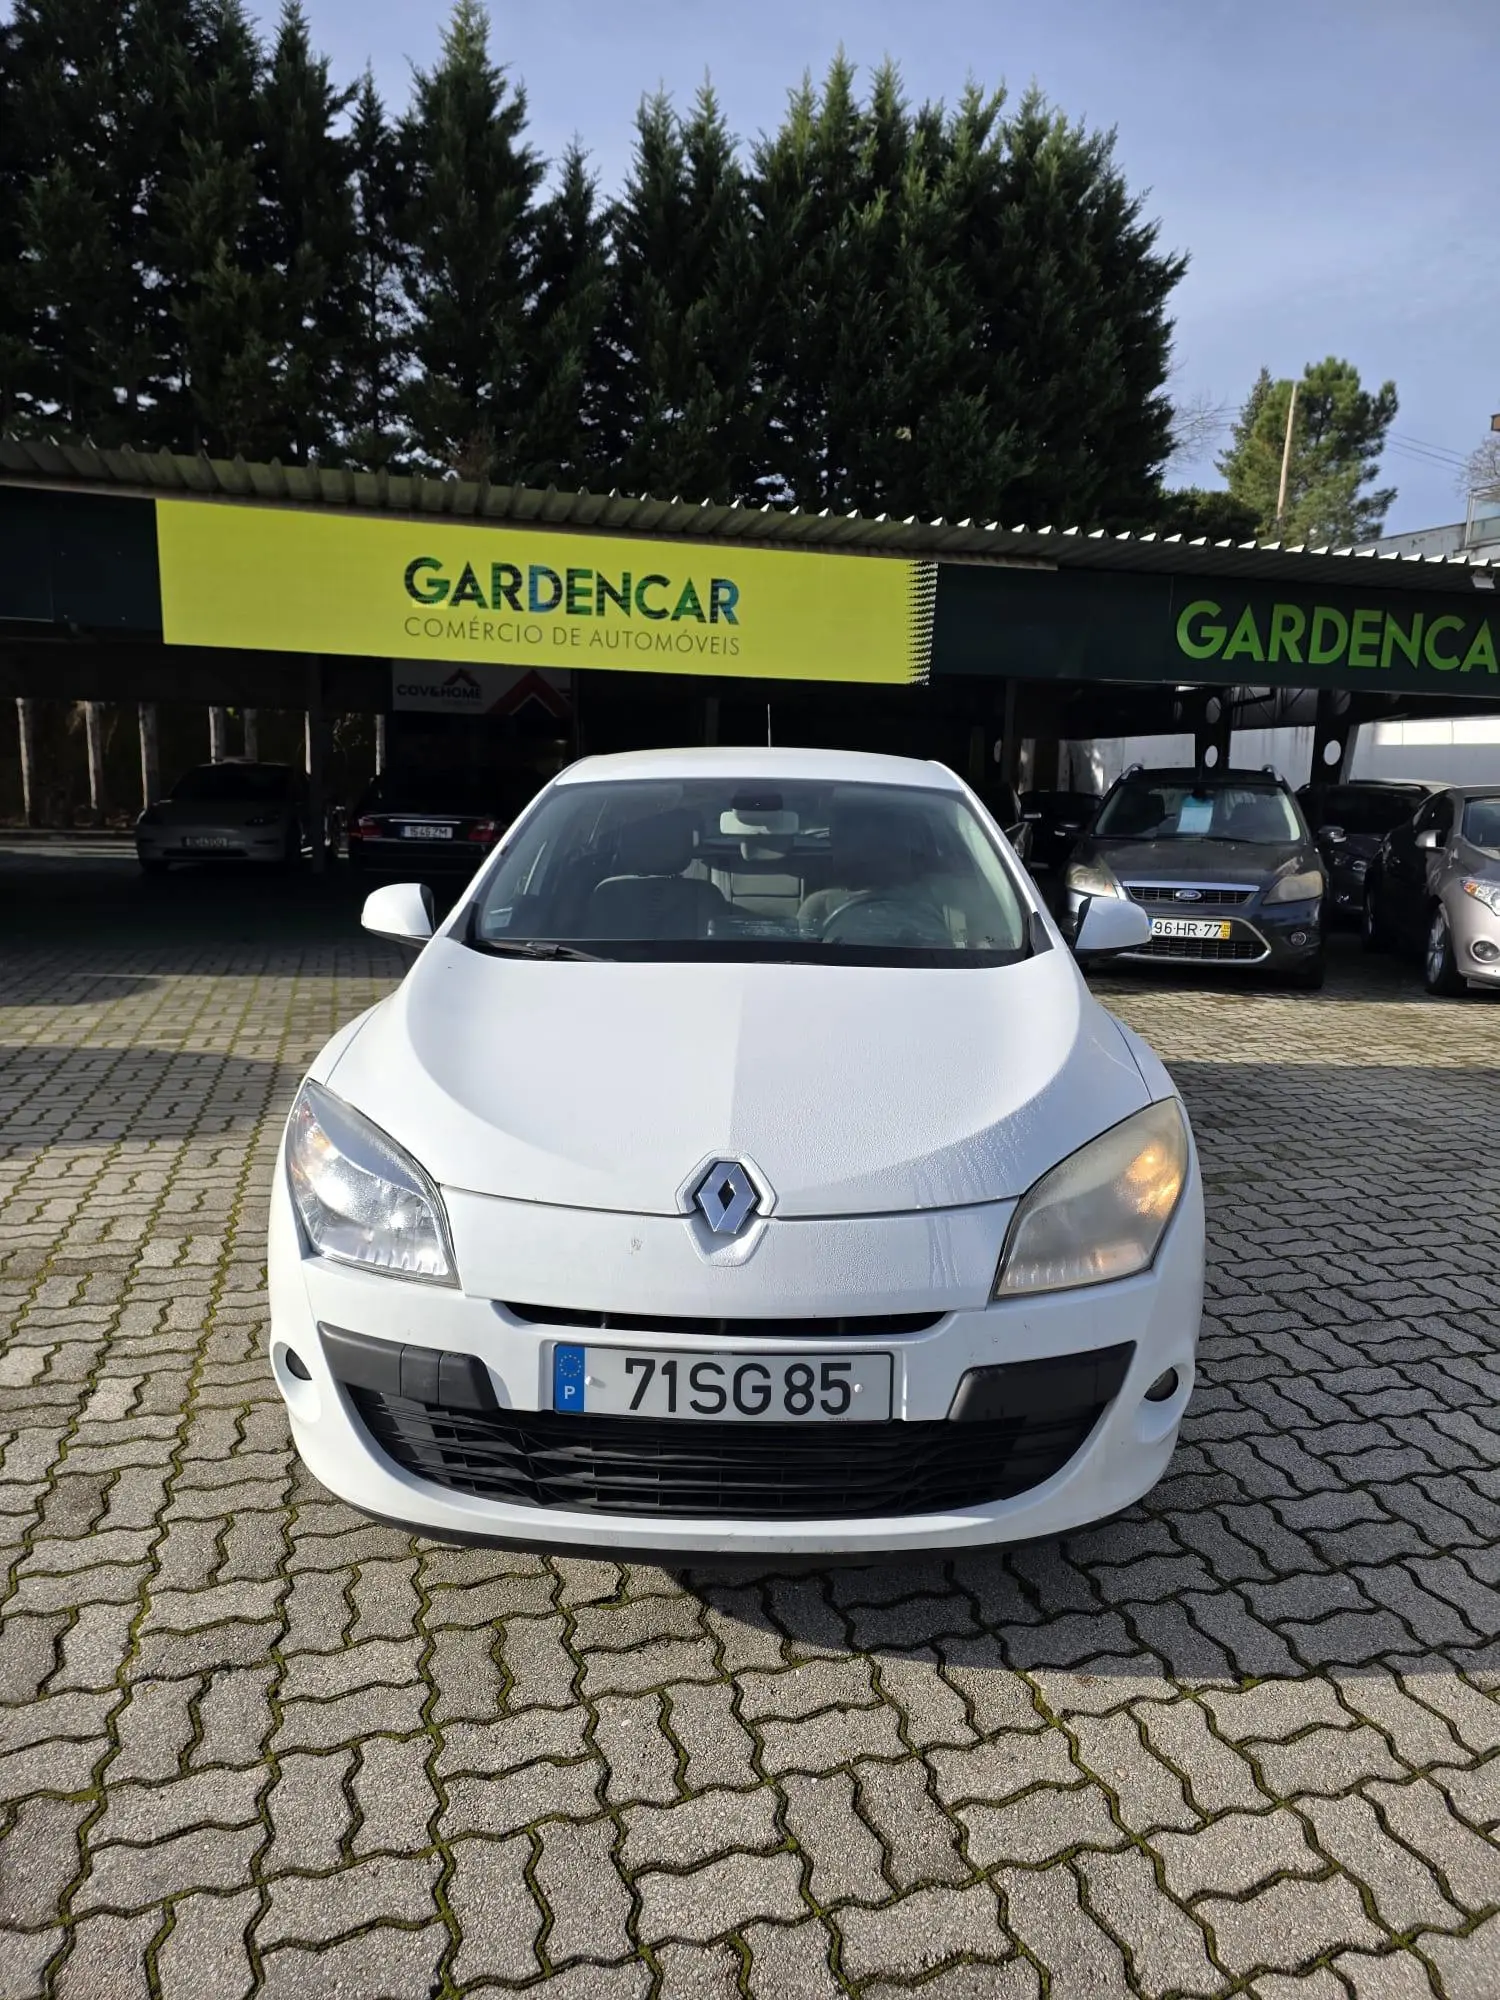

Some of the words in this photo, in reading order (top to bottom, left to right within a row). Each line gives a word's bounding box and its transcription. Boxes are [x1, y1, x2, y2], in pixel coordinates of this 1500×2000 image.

[404, 556, 740, 625] GARDENCAR
[404, 616, 543, 644] COMÉRCIO
[552, 627, 581, 646] DE
[589, 629, 740, 656] AUTOMÓVEIS
[1176, 600, 1499, 674] GARDENCA
[1154, 921, 1221, 937] 96-HR-77
[564, 1385, 576, 1400] P
